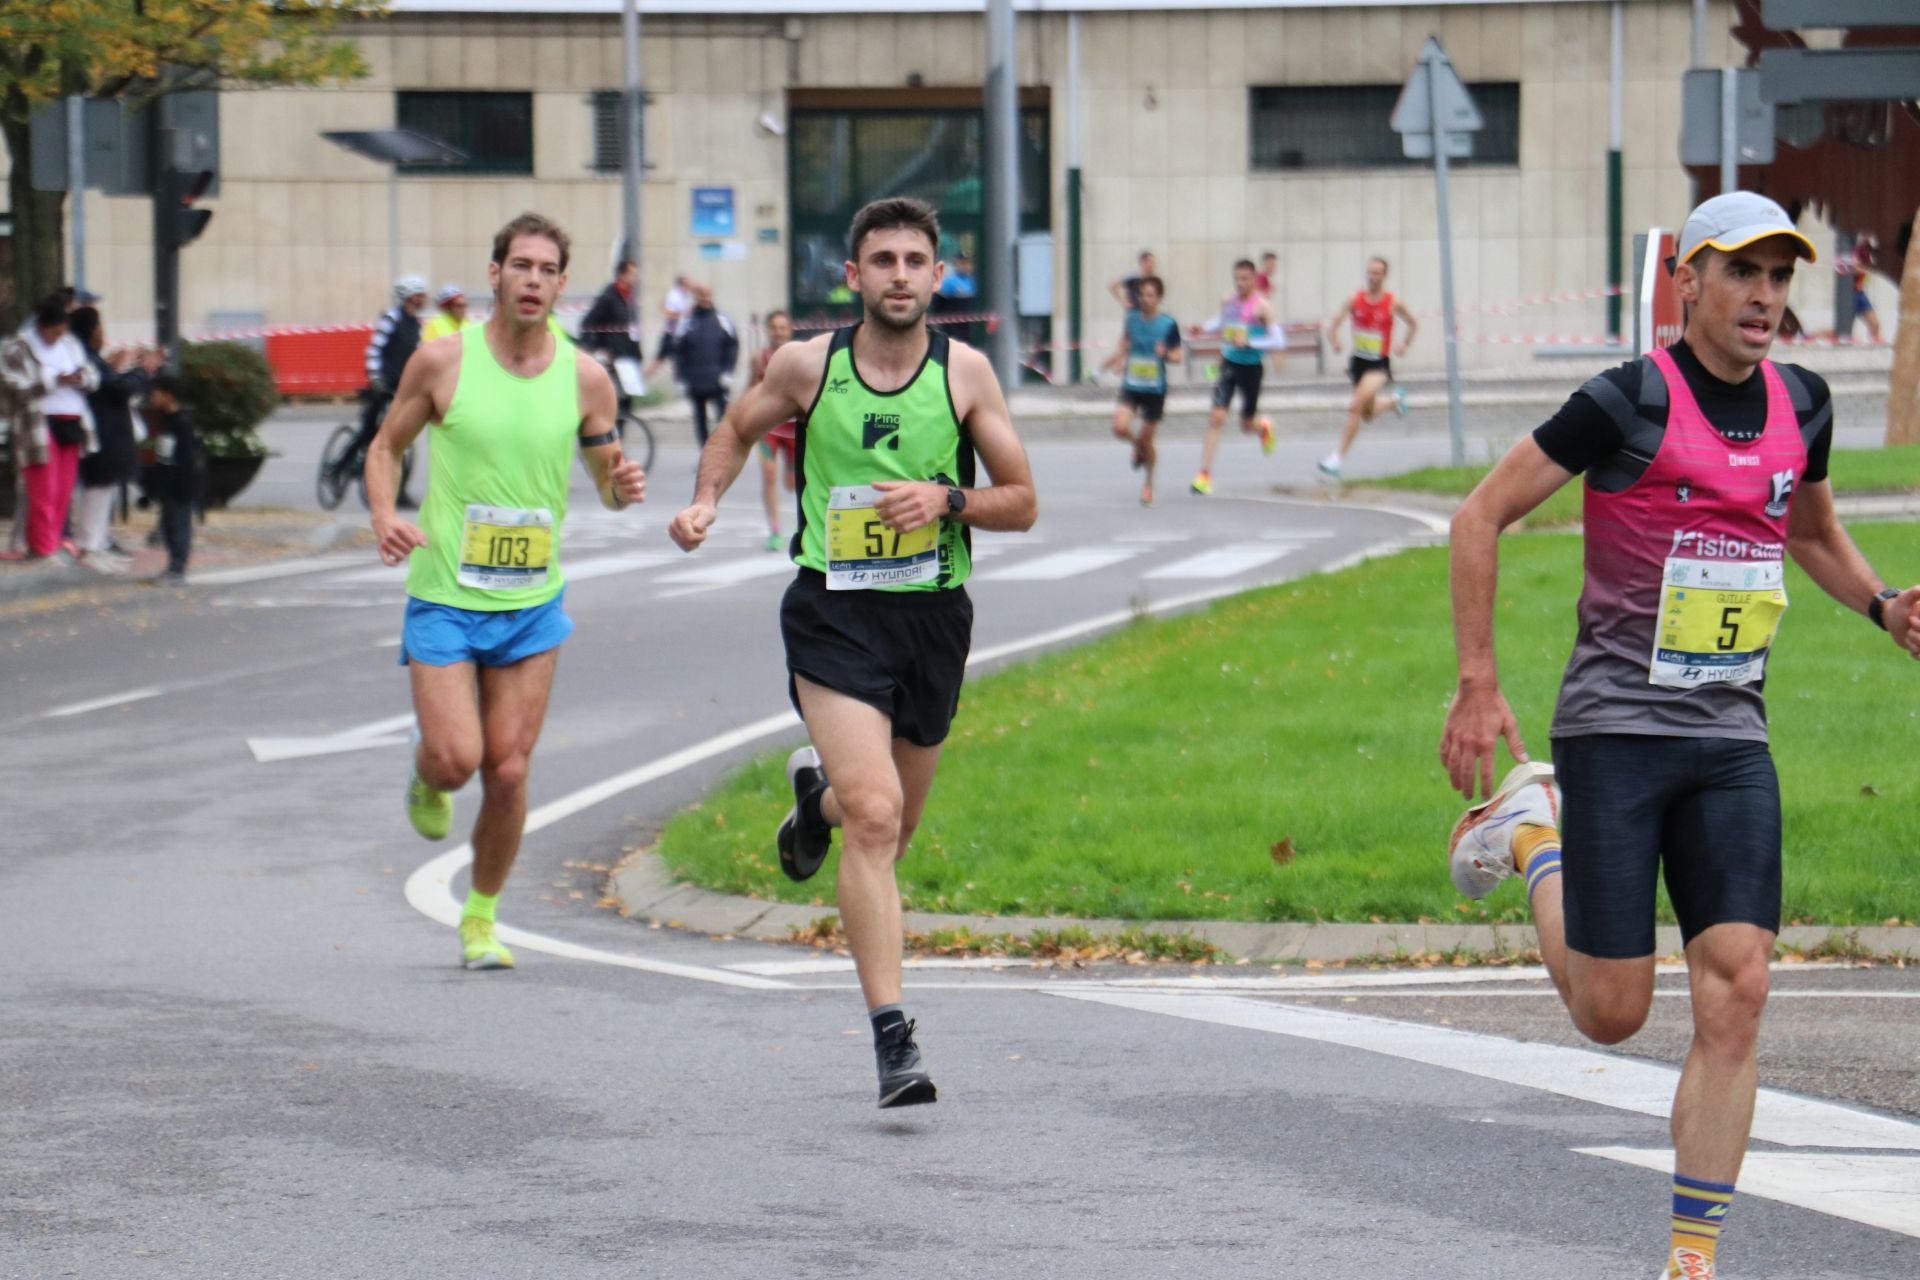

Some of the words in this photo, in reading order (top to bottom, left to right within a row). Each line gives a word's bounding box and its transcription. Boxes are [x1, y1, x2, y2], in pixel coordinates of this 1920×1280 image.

[488, 536, 529, 566] 103
[864, 521, 900, 557] 57
[871, 565, 921, 580] HYUNDAI
[1717, 607, 1742, 650] 5
